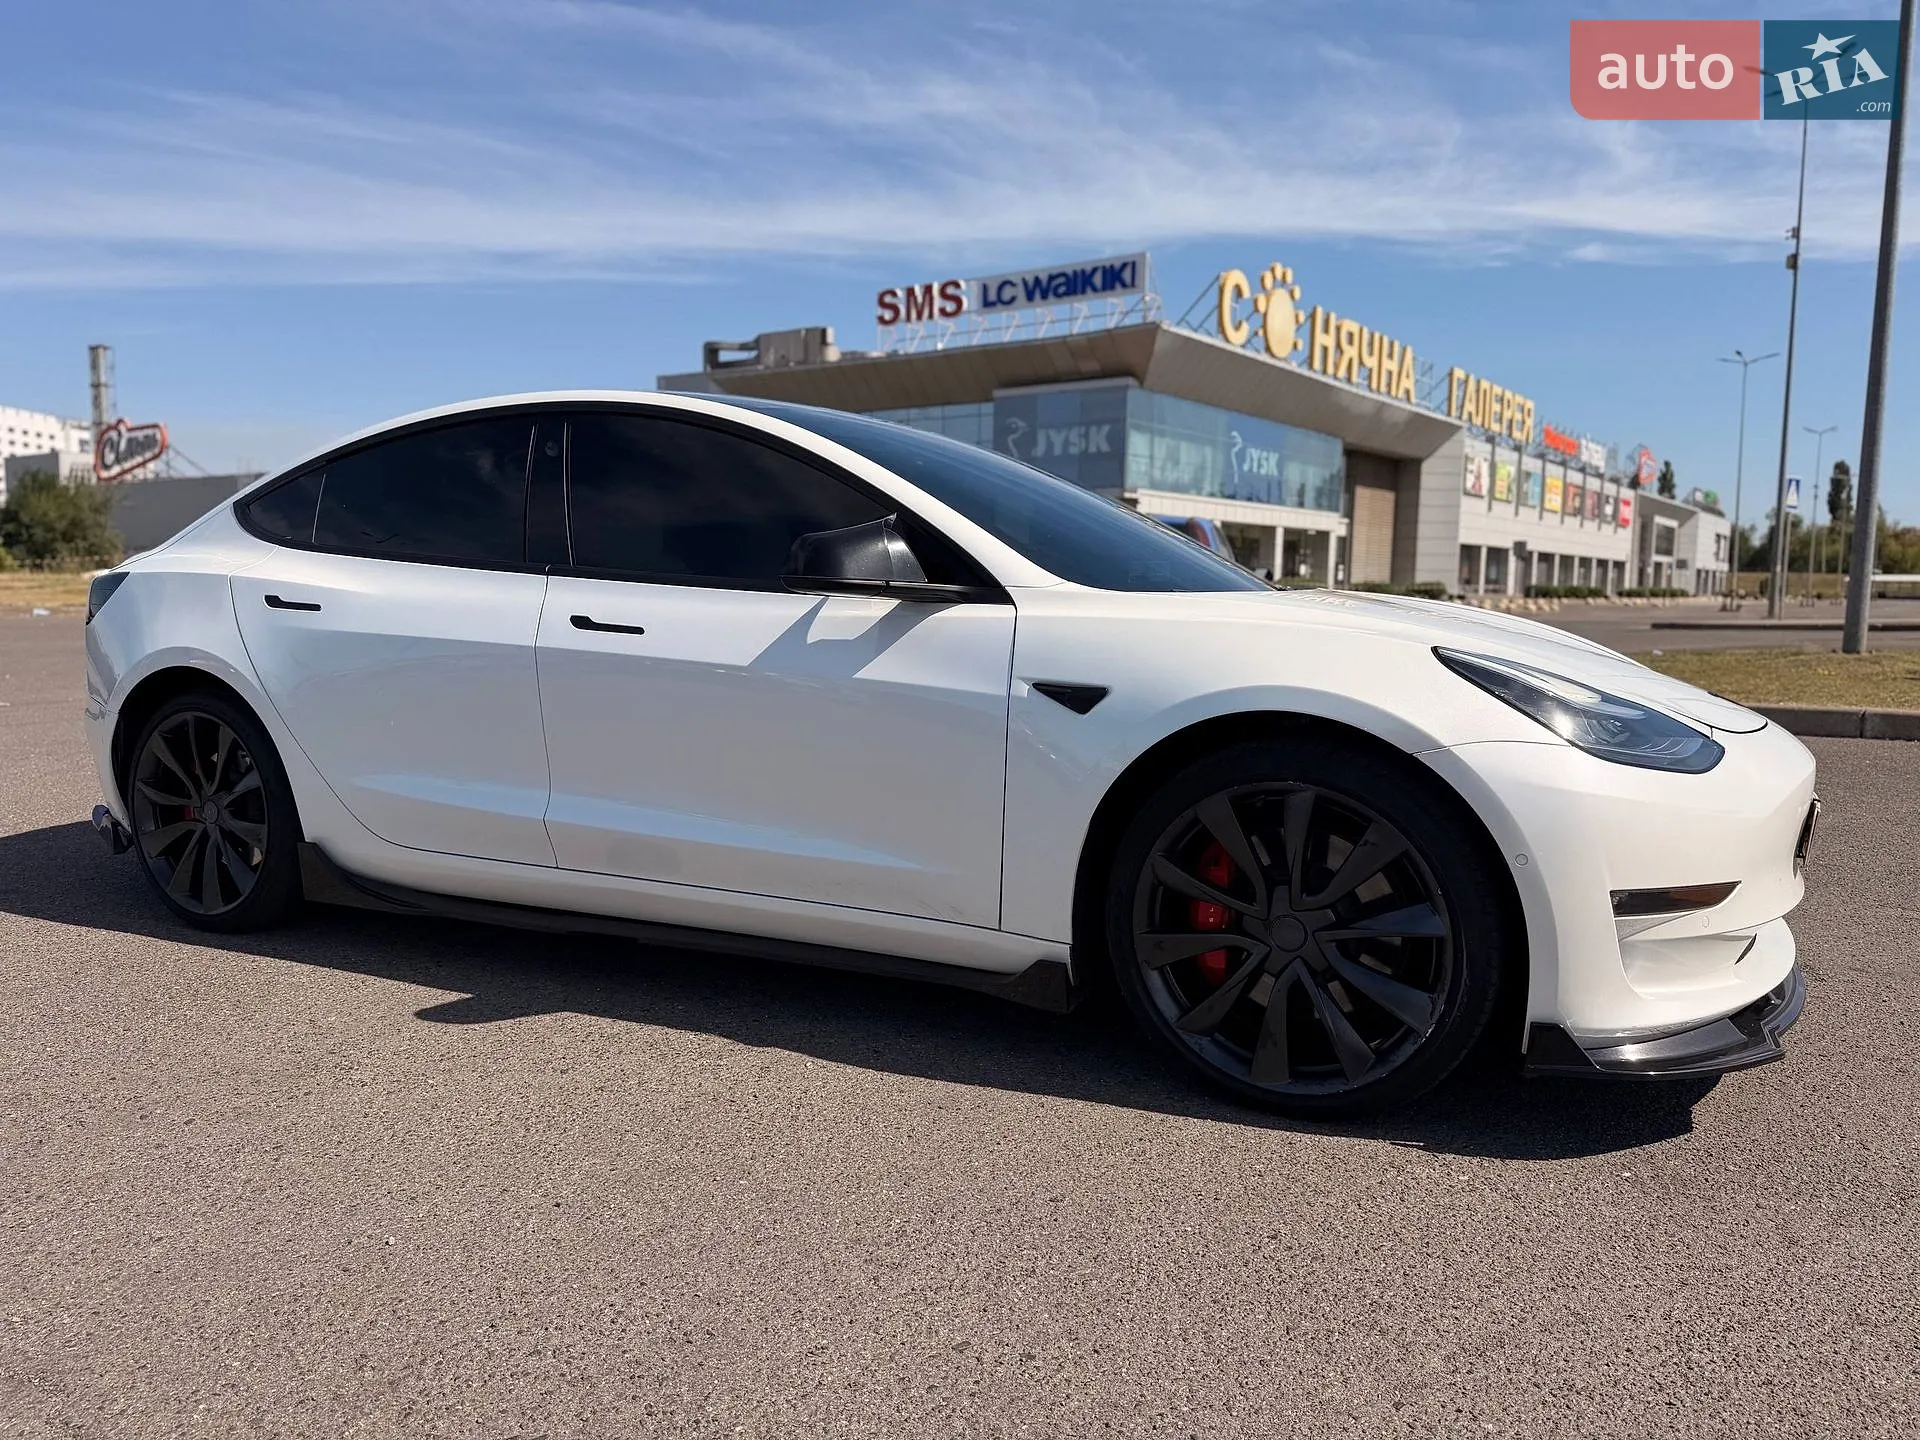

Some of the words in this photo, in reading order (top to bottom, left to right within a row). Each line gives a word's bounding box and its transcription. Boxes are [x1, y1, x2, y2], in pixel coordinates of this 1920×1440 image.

[876, 280, 966, 326] SMS
[982, 279, 1017, 309] LC
[1449, 366, 1535, 443] ГАЛЕРЕЯ
[1031, 425, 1112, 456] JYSK
[1242, 445, 1280, 477] JYSK
